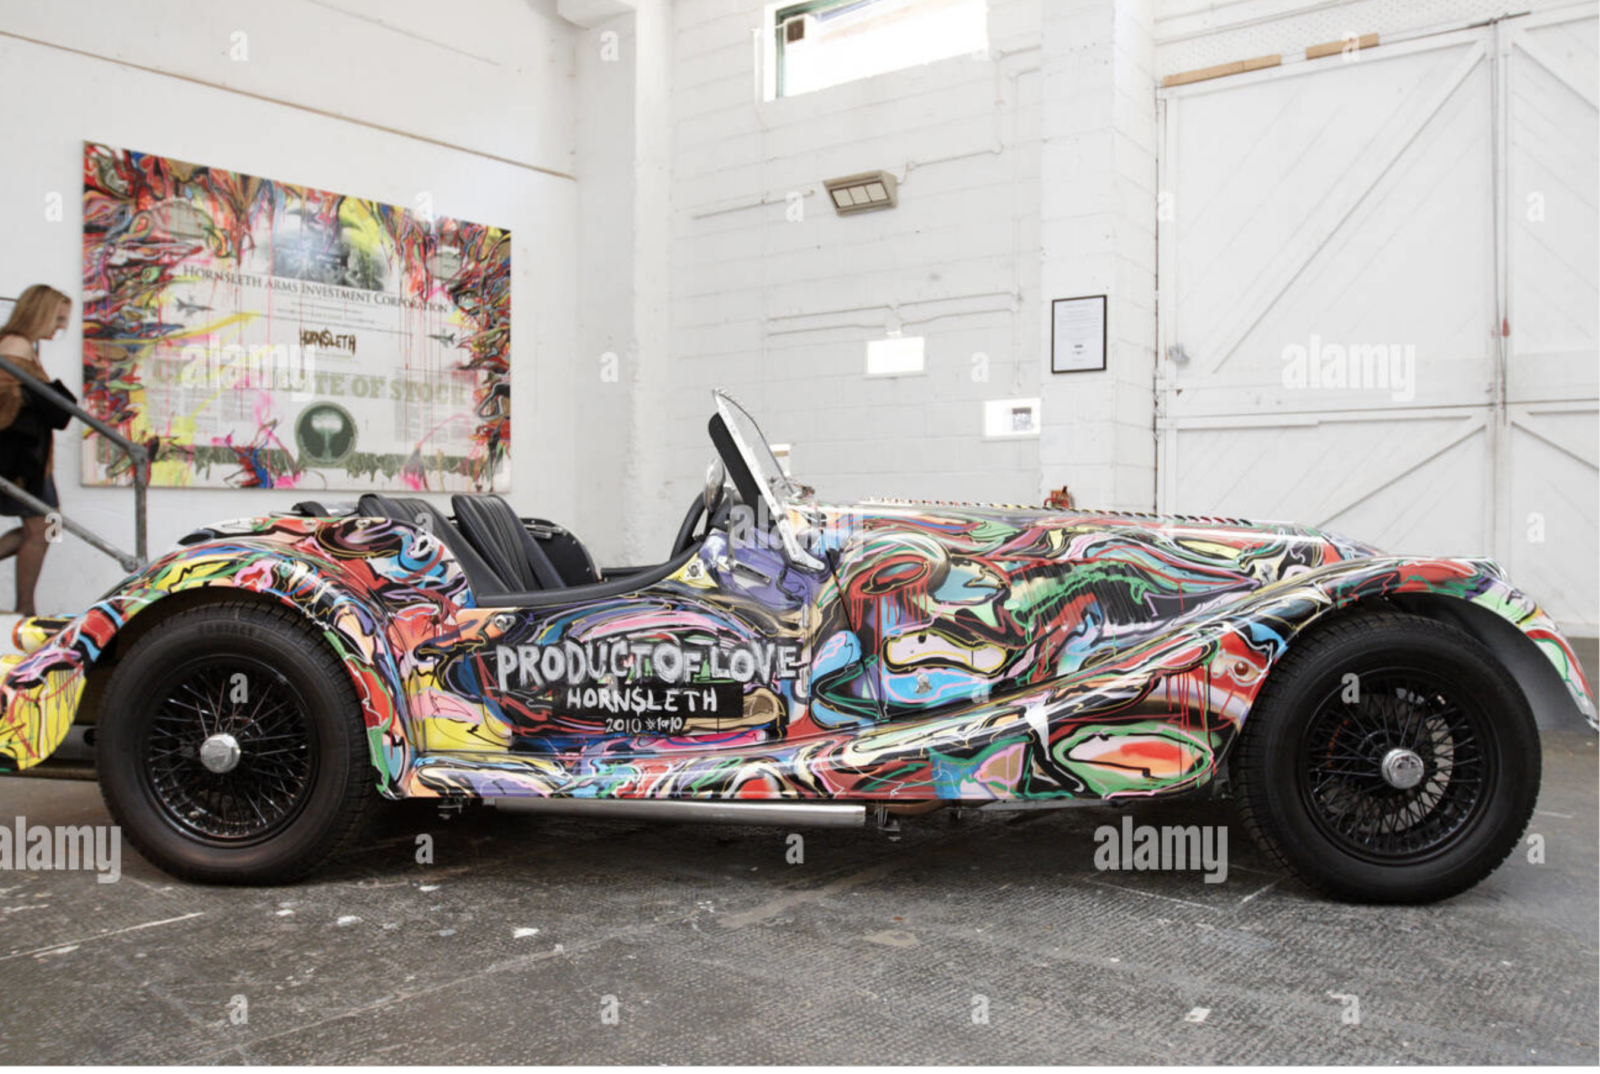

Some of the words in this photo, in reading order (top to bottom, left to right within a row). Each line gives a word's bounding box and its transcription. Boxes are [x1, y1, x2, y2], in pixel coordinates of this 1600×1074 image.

[265, 281, 298, 293] ARMS
[302, 283, 371, 303] INVESTMENT
[352, 376, 385, 399] OF
[496, 639, 650, 691] PRODUCT
[709, 640, 798, 684] LOVE
[605, 717, 642, 734] 2010
